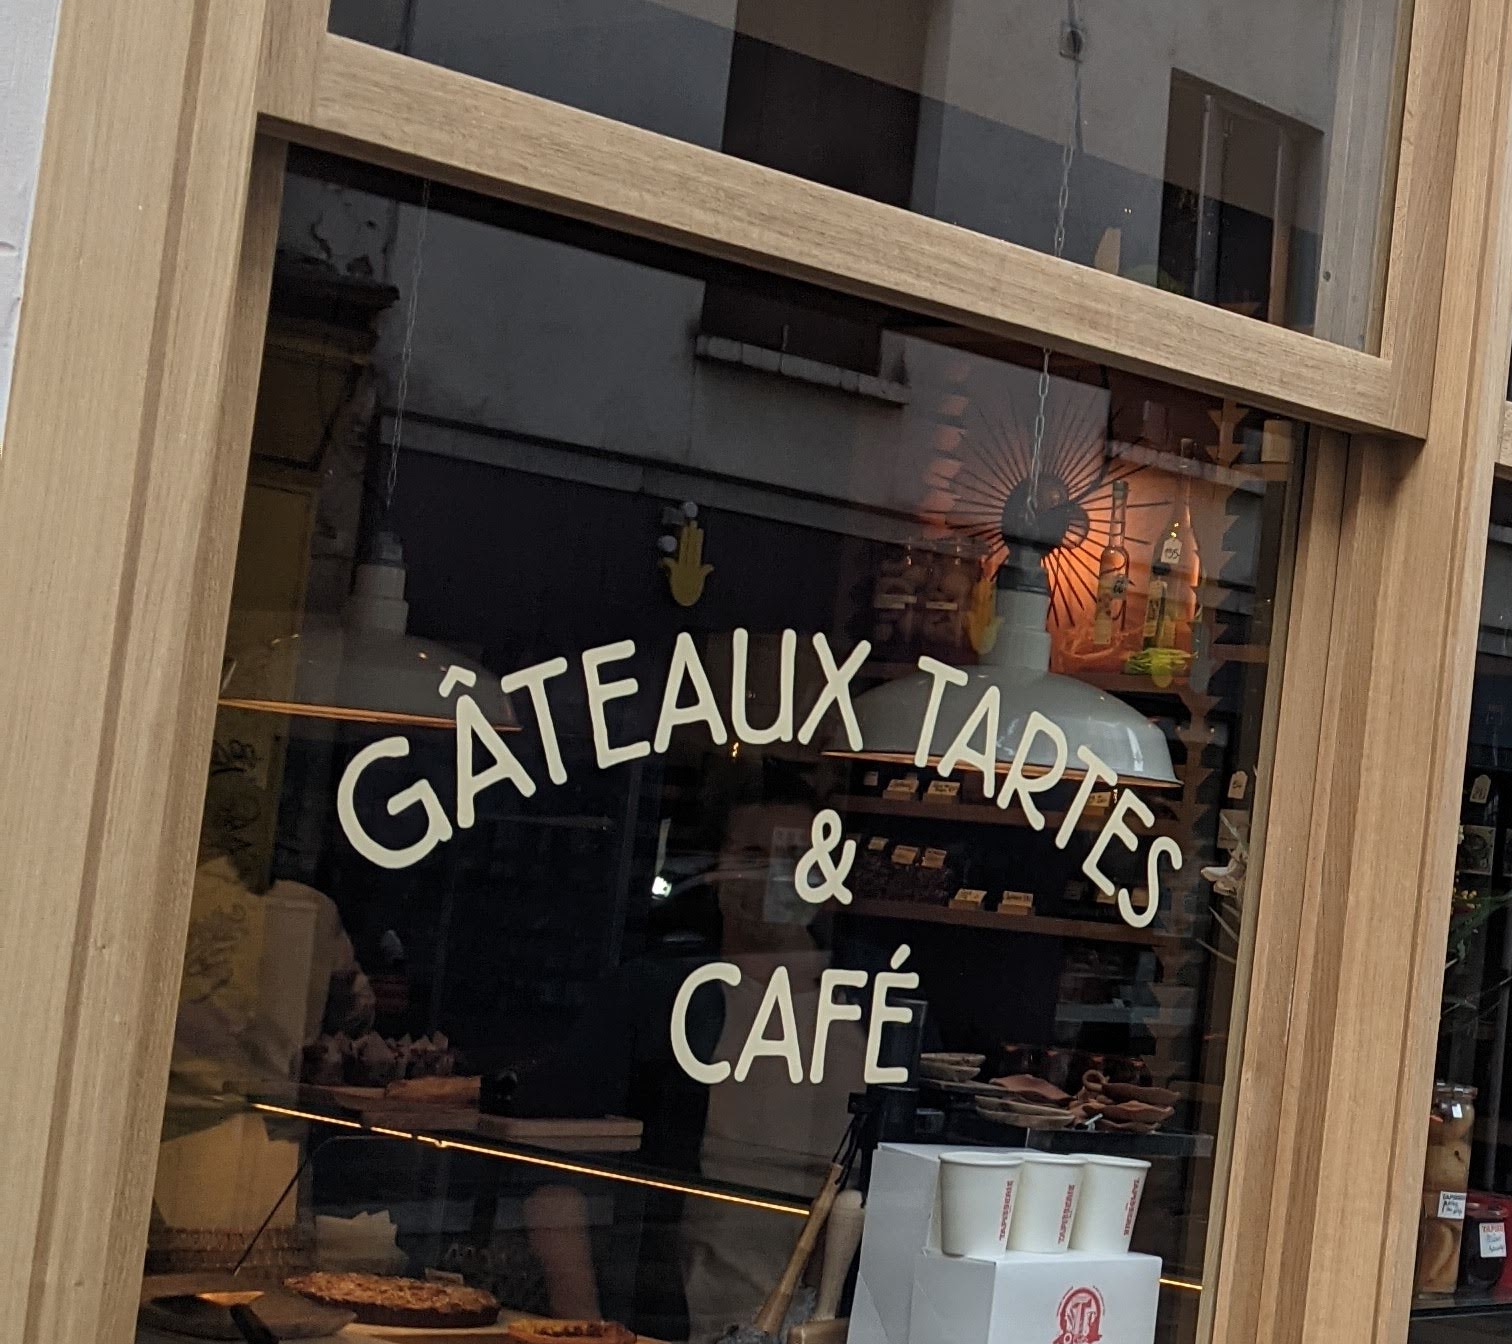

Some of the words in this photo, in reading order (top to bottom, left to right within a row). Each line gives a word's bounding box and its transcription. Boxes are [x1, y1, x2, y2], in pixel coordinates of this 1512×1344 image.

[336, 627, 873, 870] GÂTEAUX
[914, 655, 1183, 929] TARTES
[796, 807, 859, 905] &
[670, 943, 921, 1085] CAFÉ
